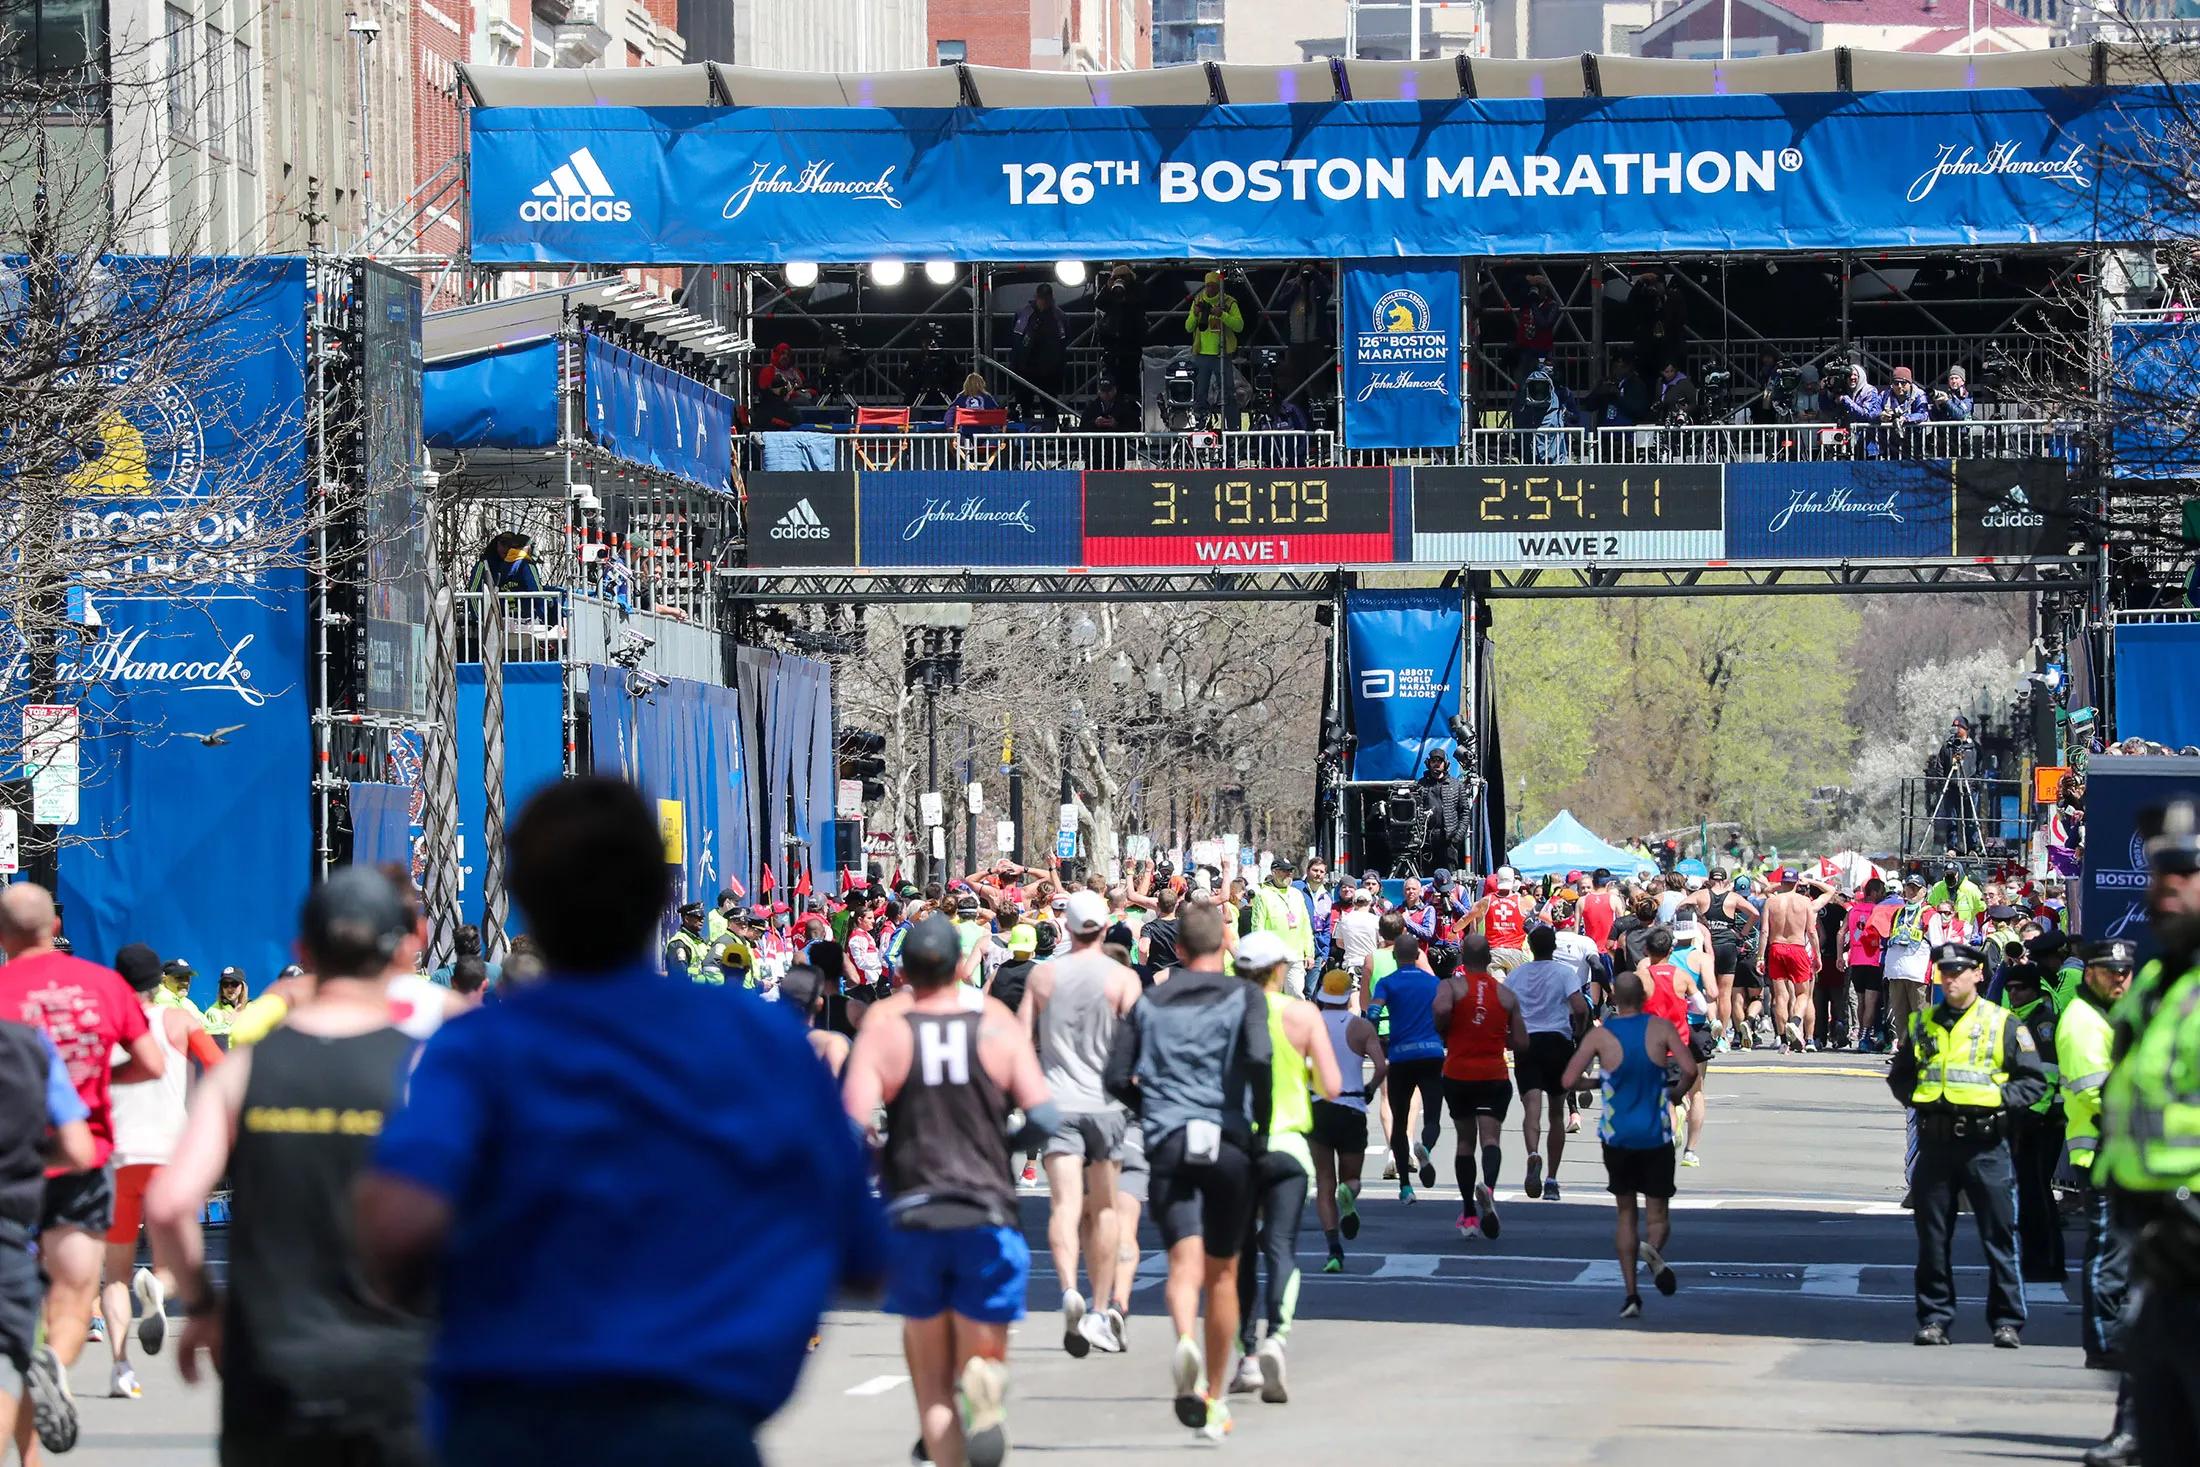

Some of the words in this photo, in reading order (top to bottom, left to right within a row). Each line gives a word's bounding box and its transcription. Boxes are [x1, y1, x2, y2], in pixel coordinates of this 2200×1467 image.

[1002, 160, 1140, 206] 126TH
[1160, 157, 1405, 204] BOSTON
[1907, 142, 1980, 203] John
[722, 160, 794, 219] John
[519, 194, 632, 222] adidas
[1358, 336, 1389, 348] 126TH
[1390, 335, 1446, 347] BOSTON
[1357, 372, 1394, 402] John
[903, 498, 957, 541] John
[1768, 489, 1829, 533] John
[1981, 511, 2044, 528] adidas
[70, 510, 255, 543] BOSTON
[770, 523, 830, 540] adidas
[1195, 541, 1274, 561] WAVE
[1279, 540, 1289, 559] 1
[1518, 537, 1598, 556] WAVE
[1604, 537, 1618, 555] 2
[1399, 668, 1434, 676] ABBOTT
[2133, 836, 2144, 866] BOSTO
[919, 1020, 970, 1087] H
